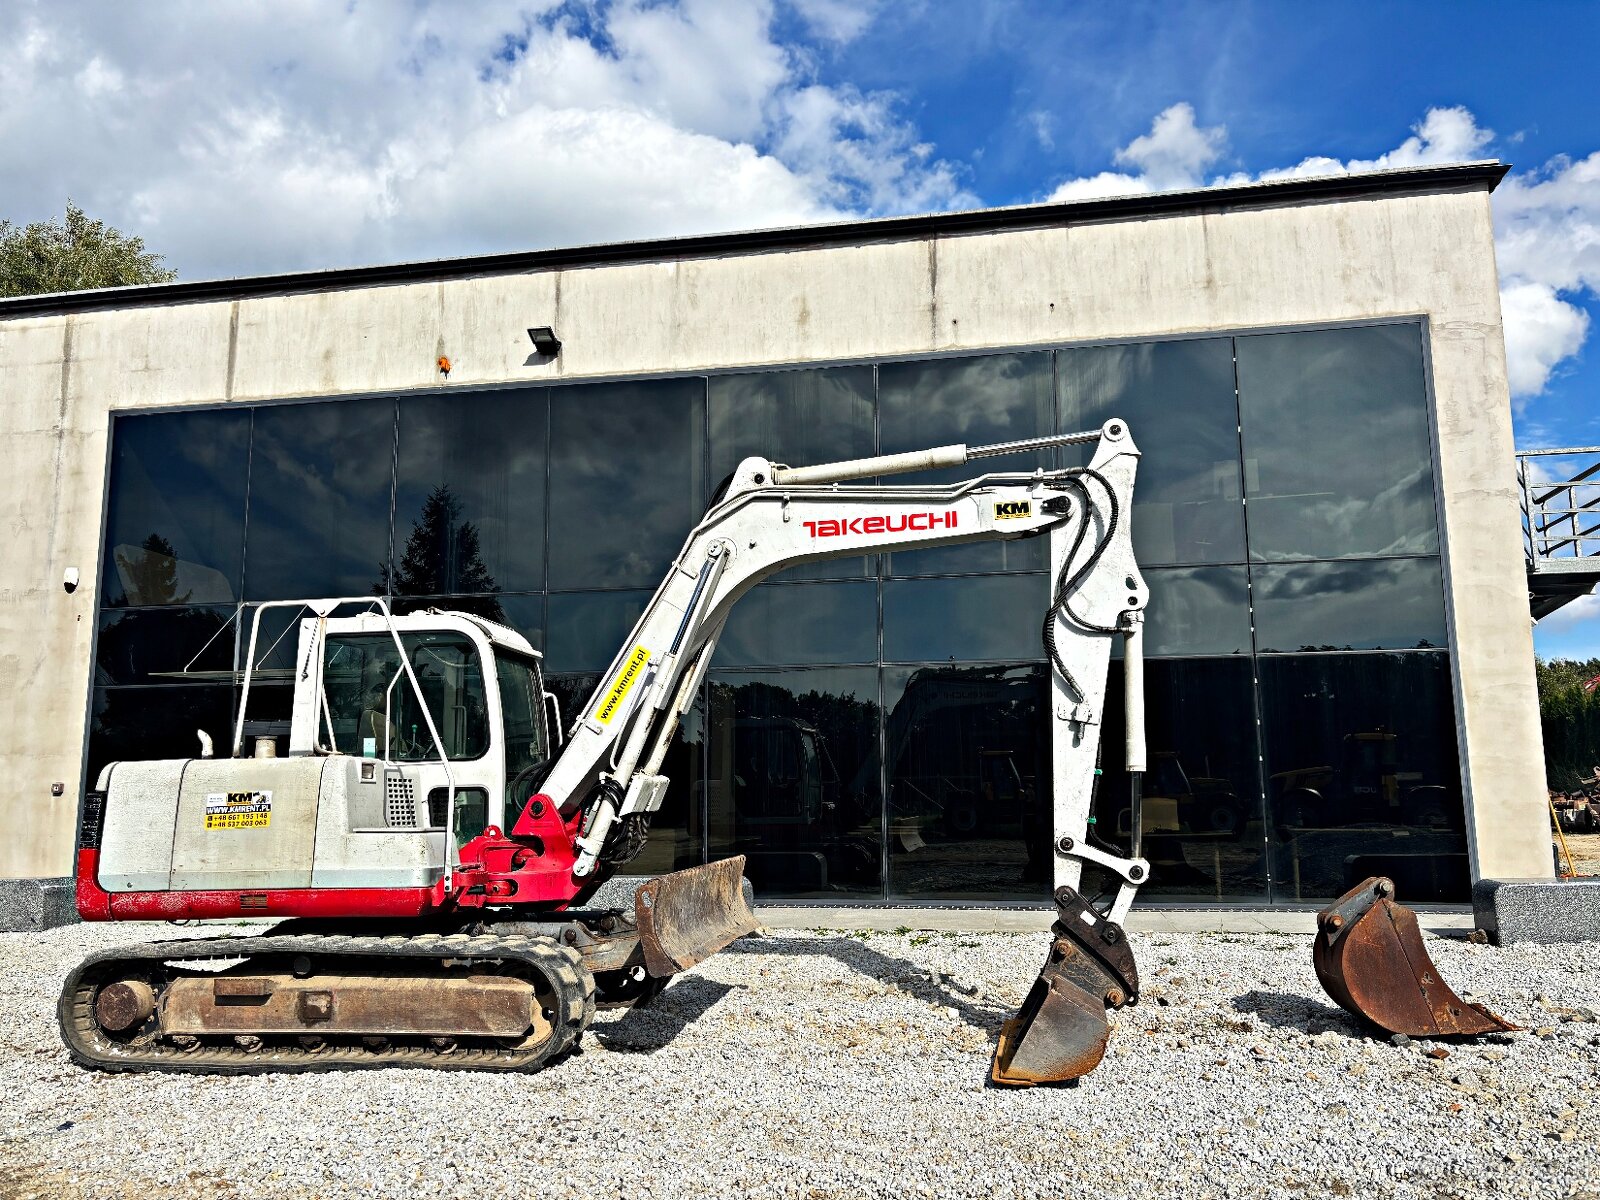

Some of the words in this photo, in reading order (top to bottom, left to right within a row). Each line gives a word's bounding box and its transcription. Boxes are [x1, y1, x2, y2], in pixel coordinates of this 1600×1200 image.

[996, 502, 1030, 515] KM
[803, 511, 957, 538] TAKEUCHI
[601, 649, 646, 719] www.kmrent.pl
[227, 792, 253, 803] KM
